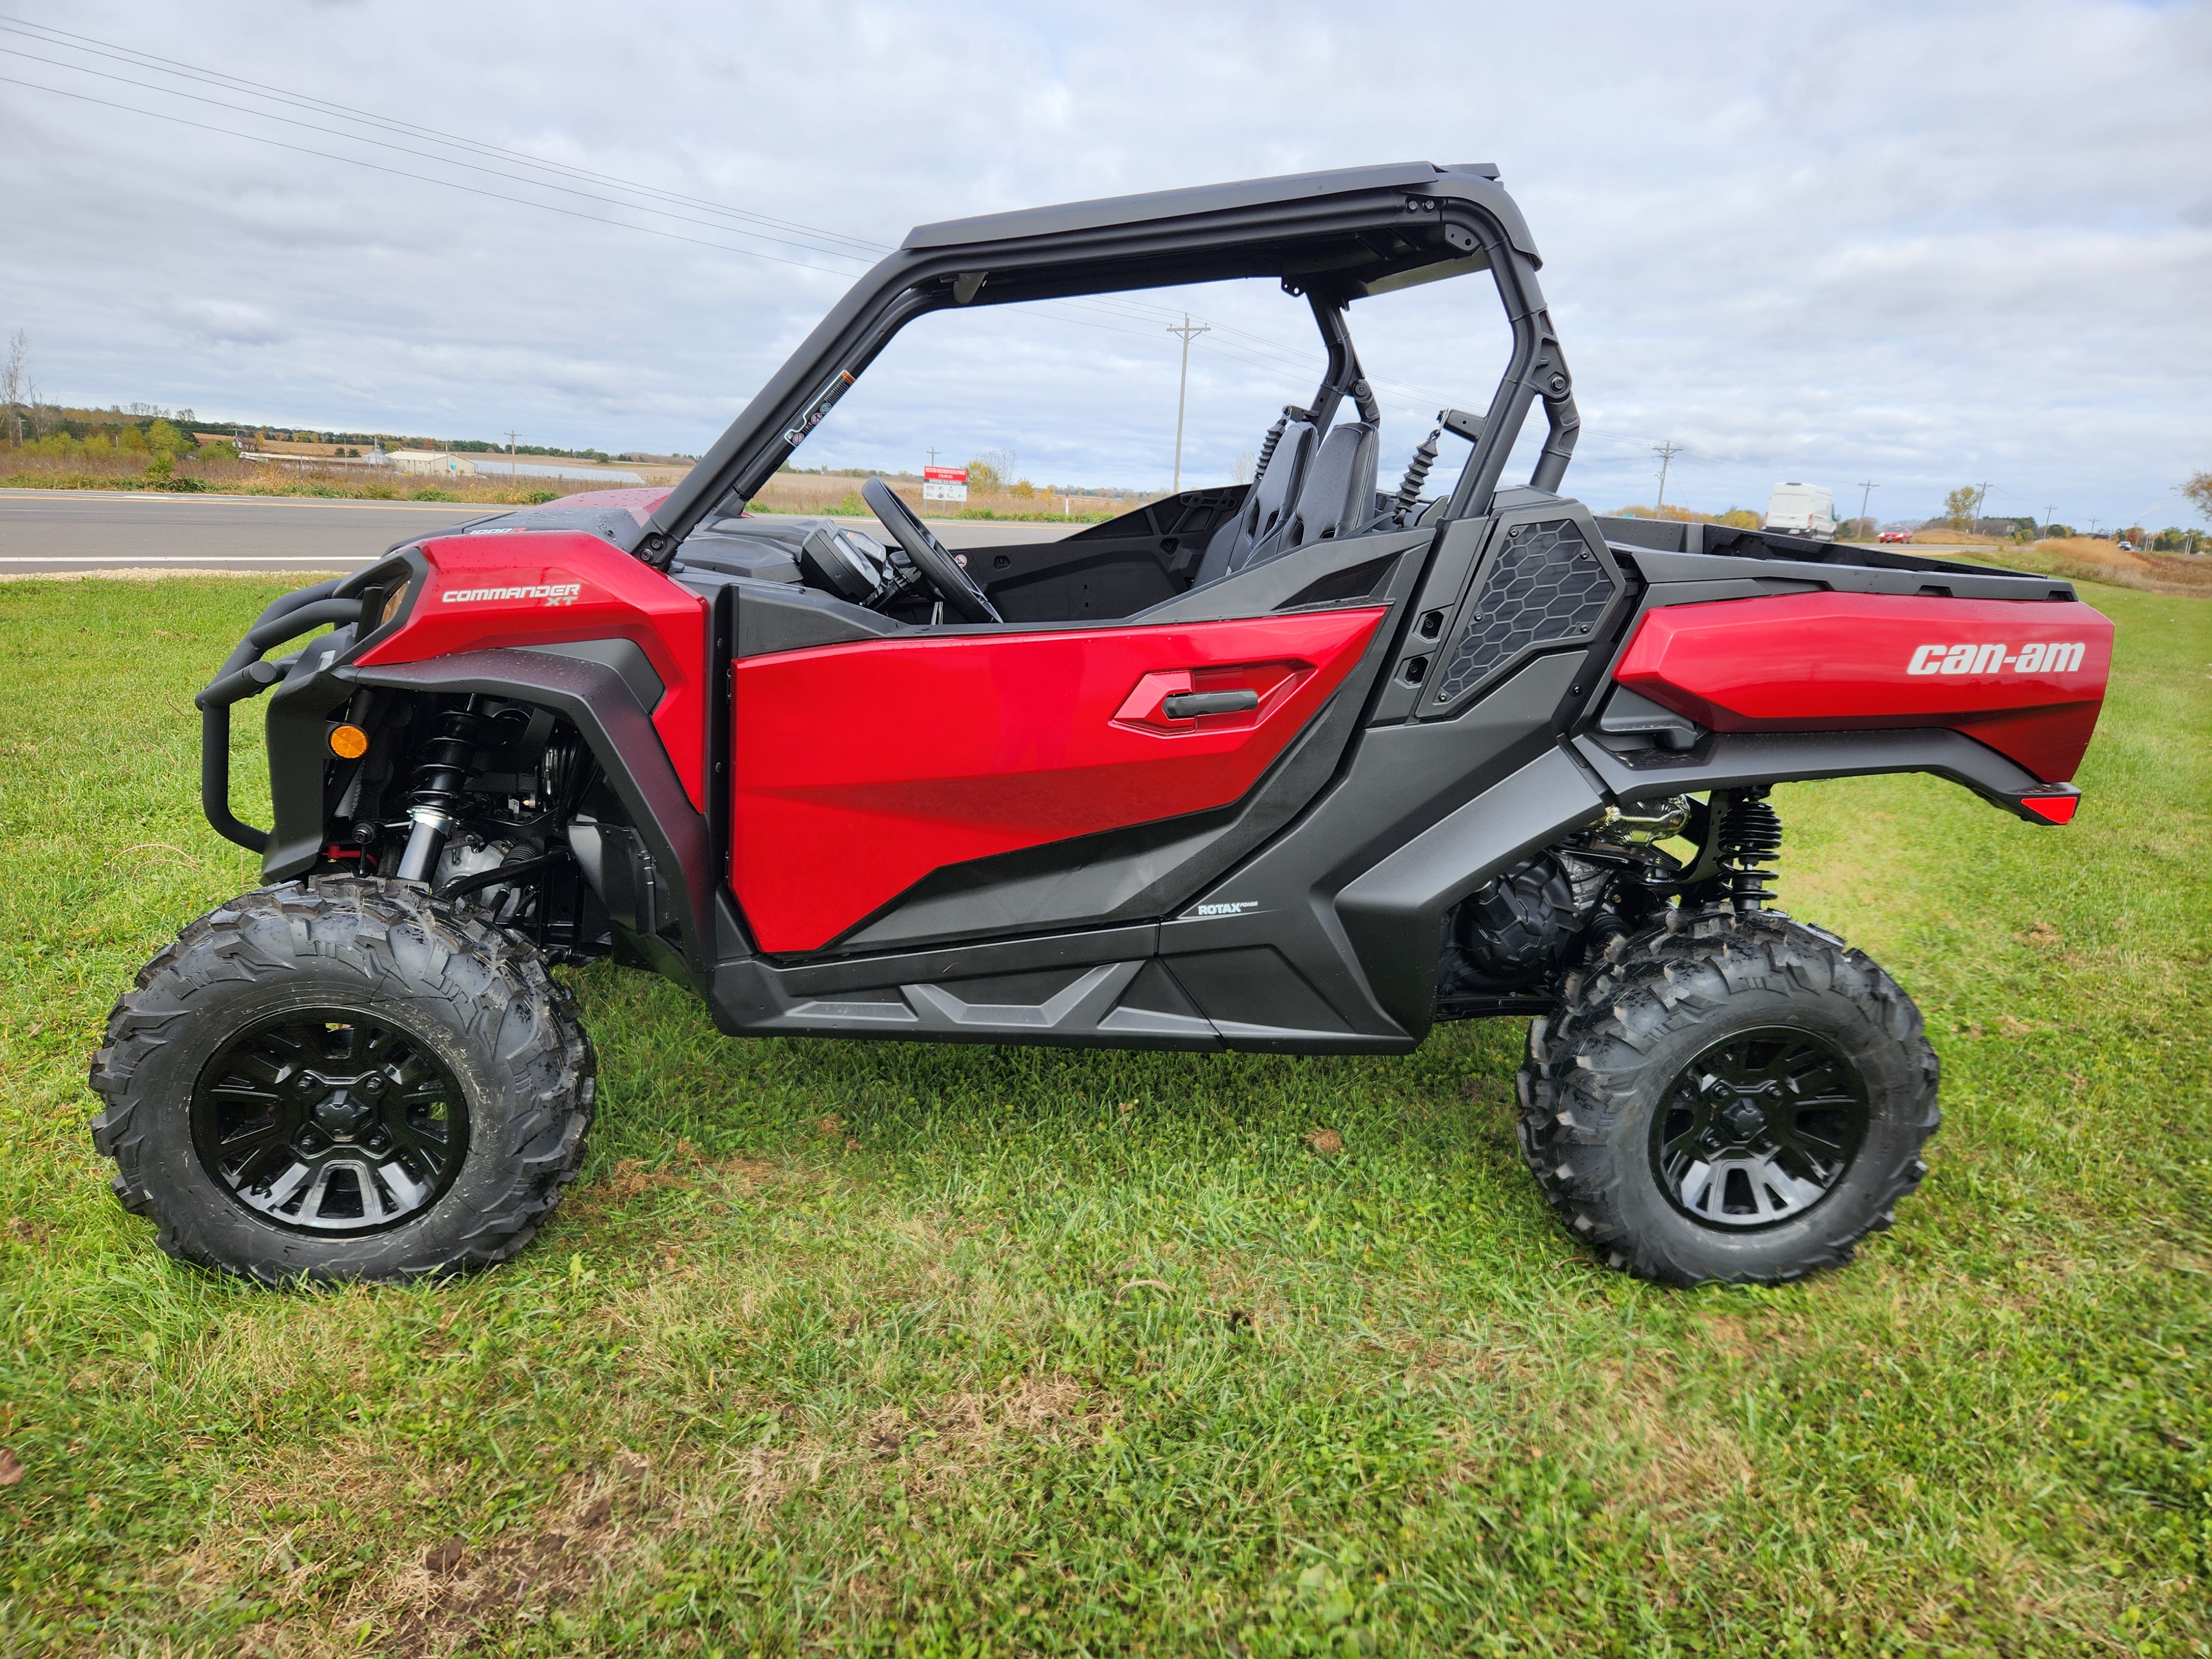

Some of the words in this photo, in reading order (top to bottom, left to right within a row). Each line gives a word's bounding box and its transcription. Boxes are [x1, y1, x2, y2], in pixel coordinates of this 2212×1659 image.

[442, 584, 580, 602] COMMANDER
[545, 596, 577, 607] XT
[1907, 643, 2085, 675] can-am
[1198, 902, 1241, 915] ROTAX
